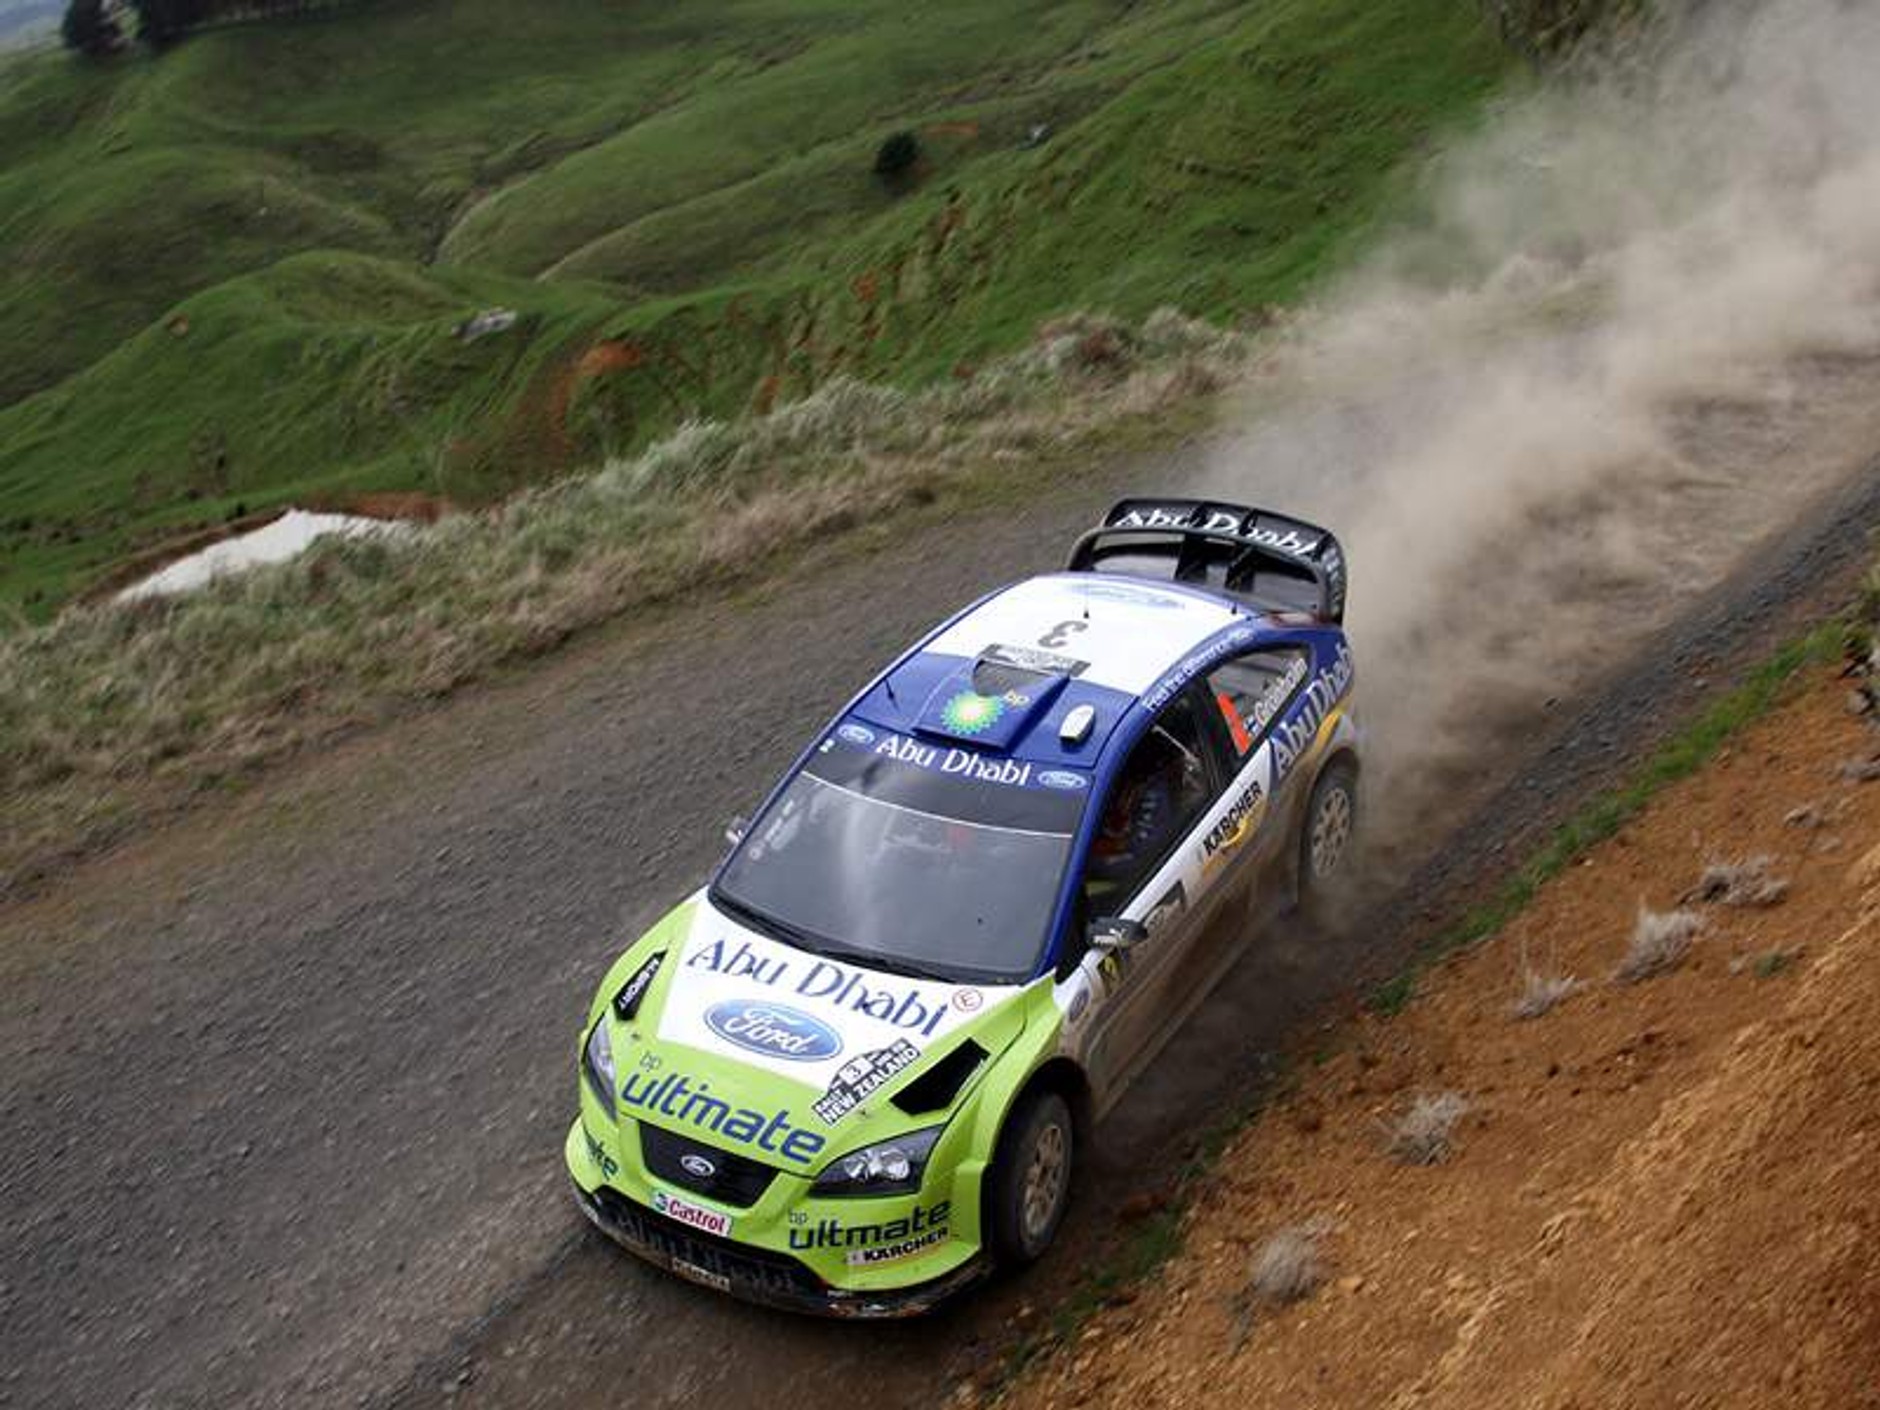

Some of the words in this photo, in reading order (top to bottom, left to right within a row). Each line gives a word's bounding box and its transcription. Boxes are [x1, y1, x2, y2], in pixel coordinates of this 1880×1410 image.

[1038, 620, 1088, 648] 3
[1003, 689, 1030, 707] bp
[1270, 703, 1319, 781] Abu
[1305, 642, 1354, 722] Dhab
[875, 733, 938, 767] Abu
[940, 747, 1032, 786] Dhabi
[686, 939, 788, 986] Abu
[795, 961, 950, 1037] Dhabi
[722, 1004, 811, 1056] Ford
[639, 1051, 662, 1072] bp
[822, 1093, 856, 1124] NEW
[853, 1047, 918, 1098] ZEALAND
[621, 1073, 827, 1165] ultimate
[669, 1199, 725, 1232] Castrol
